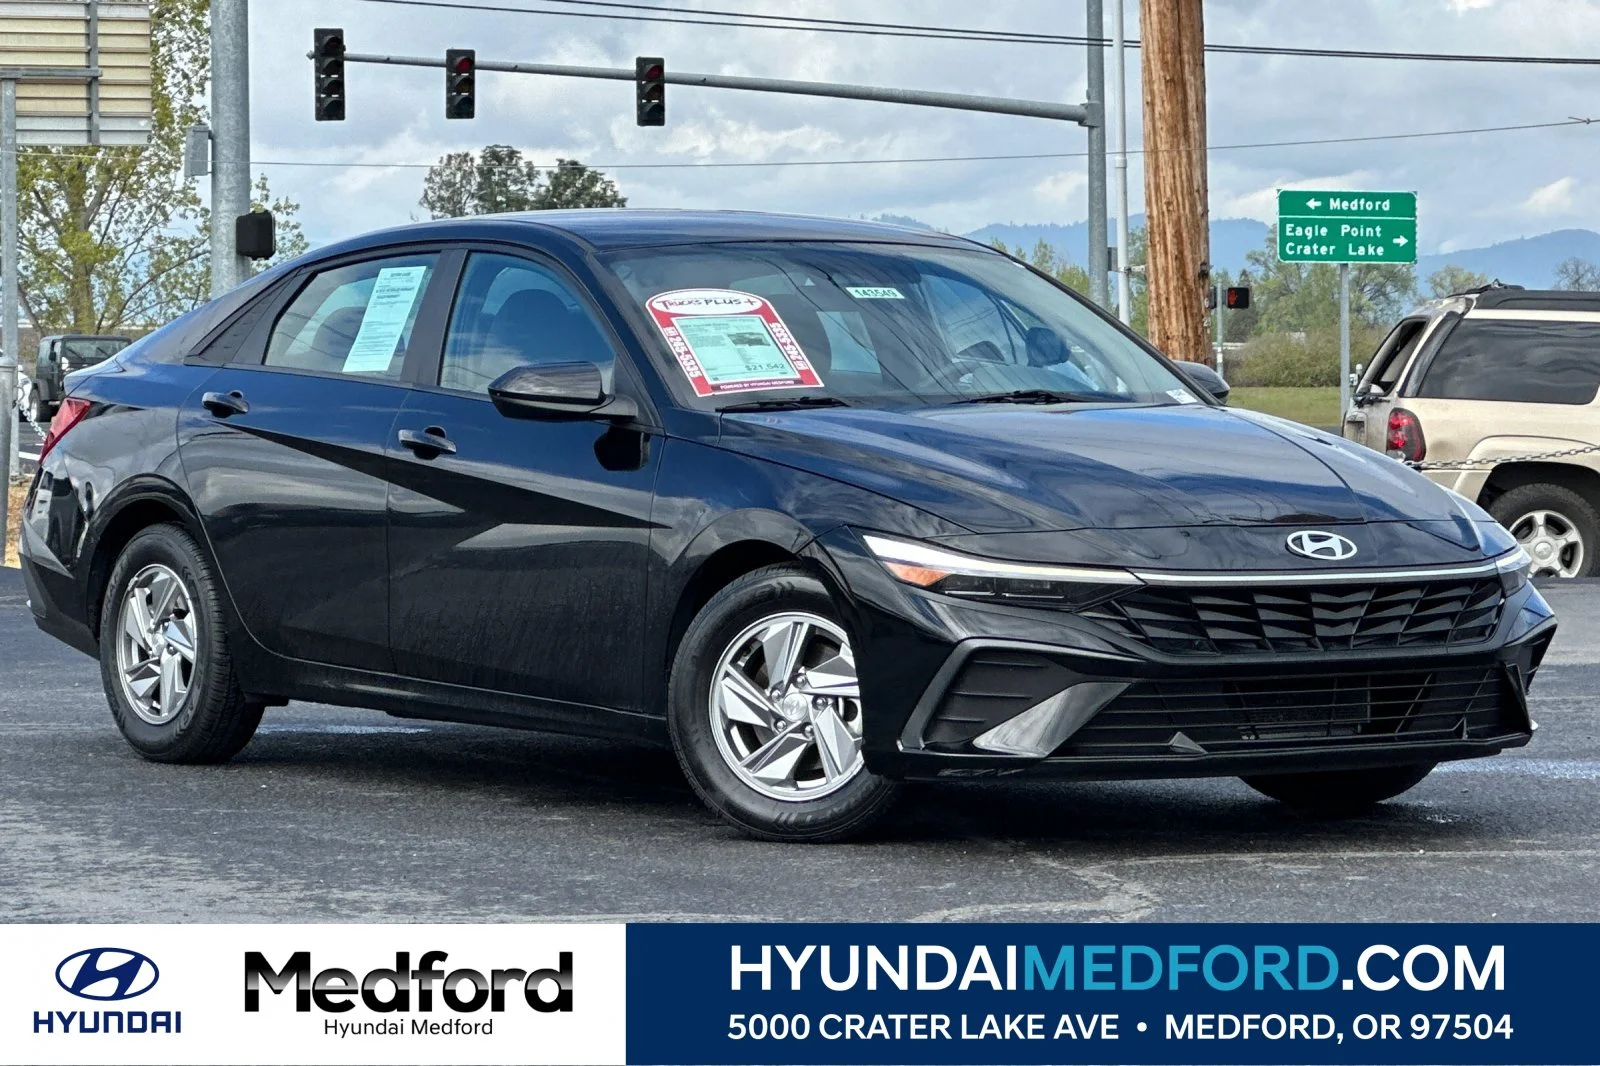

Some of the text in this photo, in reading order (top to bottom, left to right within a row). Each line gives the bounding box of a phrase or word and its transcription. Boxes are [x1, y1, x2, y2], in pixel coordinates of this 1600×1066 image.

[1329, 197, 1391, 211] Medford
[1285, 223, 1383, 240] Eagle Point
[1285, 242, 1385, 256] Crater Lake
[854, 288, 898, 298] 143549
